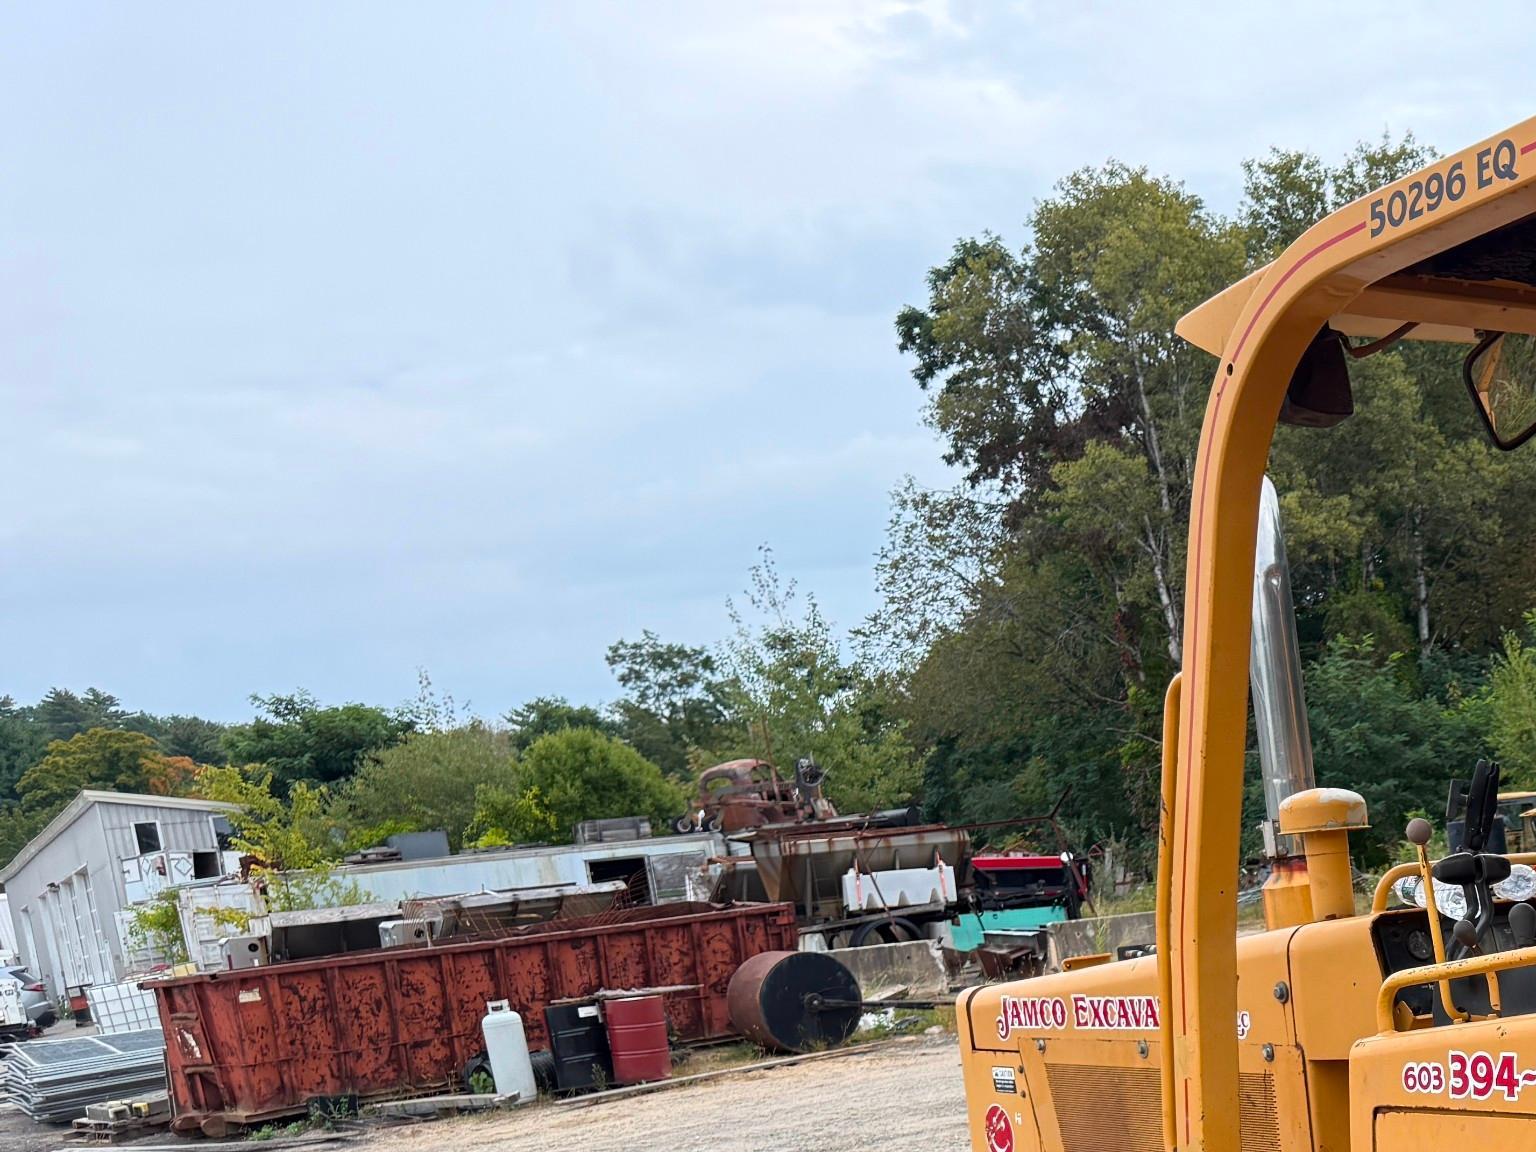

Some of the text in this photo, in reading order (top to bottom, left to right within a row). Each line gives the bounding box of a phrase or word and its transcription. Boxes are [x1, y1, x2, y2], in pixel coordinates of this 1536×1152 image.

[1370, 139, 1519, 239] 50296 EQ
[997, 996, 1161, 1038] JAMCO EXCAVA
[1403, 1065, 1444, 1091] 603
